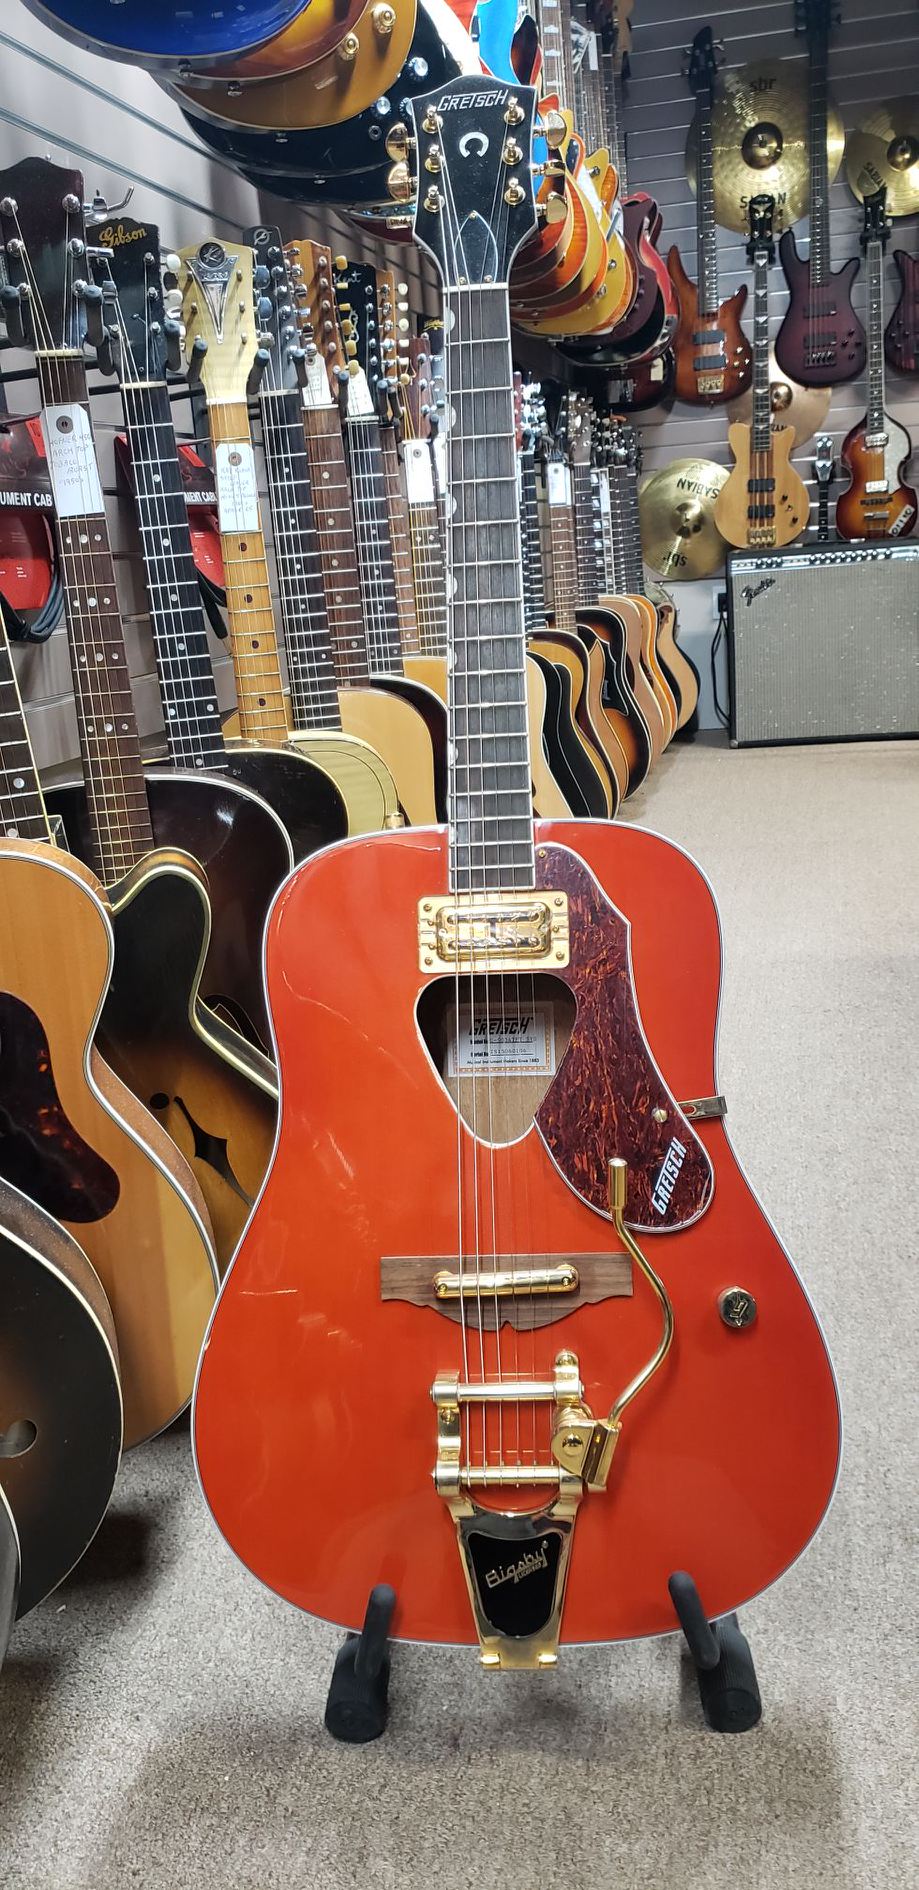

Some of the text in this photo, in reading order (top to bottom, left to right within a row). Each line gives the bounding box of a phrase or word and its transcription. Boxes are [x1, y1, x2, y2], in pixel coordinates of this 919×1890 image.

[749, 75, 777, 91] sbr
[437, 89, 509, 112] GRETSCH
[99, 224, 147, 248] Gibson
[676, 477, 720, 500] SABIAN
[468, 1017, 531, 1036] GRETSCH
[652, 1136, 687, 1215] GRETSCH
[485, 1547, 548, 1589] Bigsby
